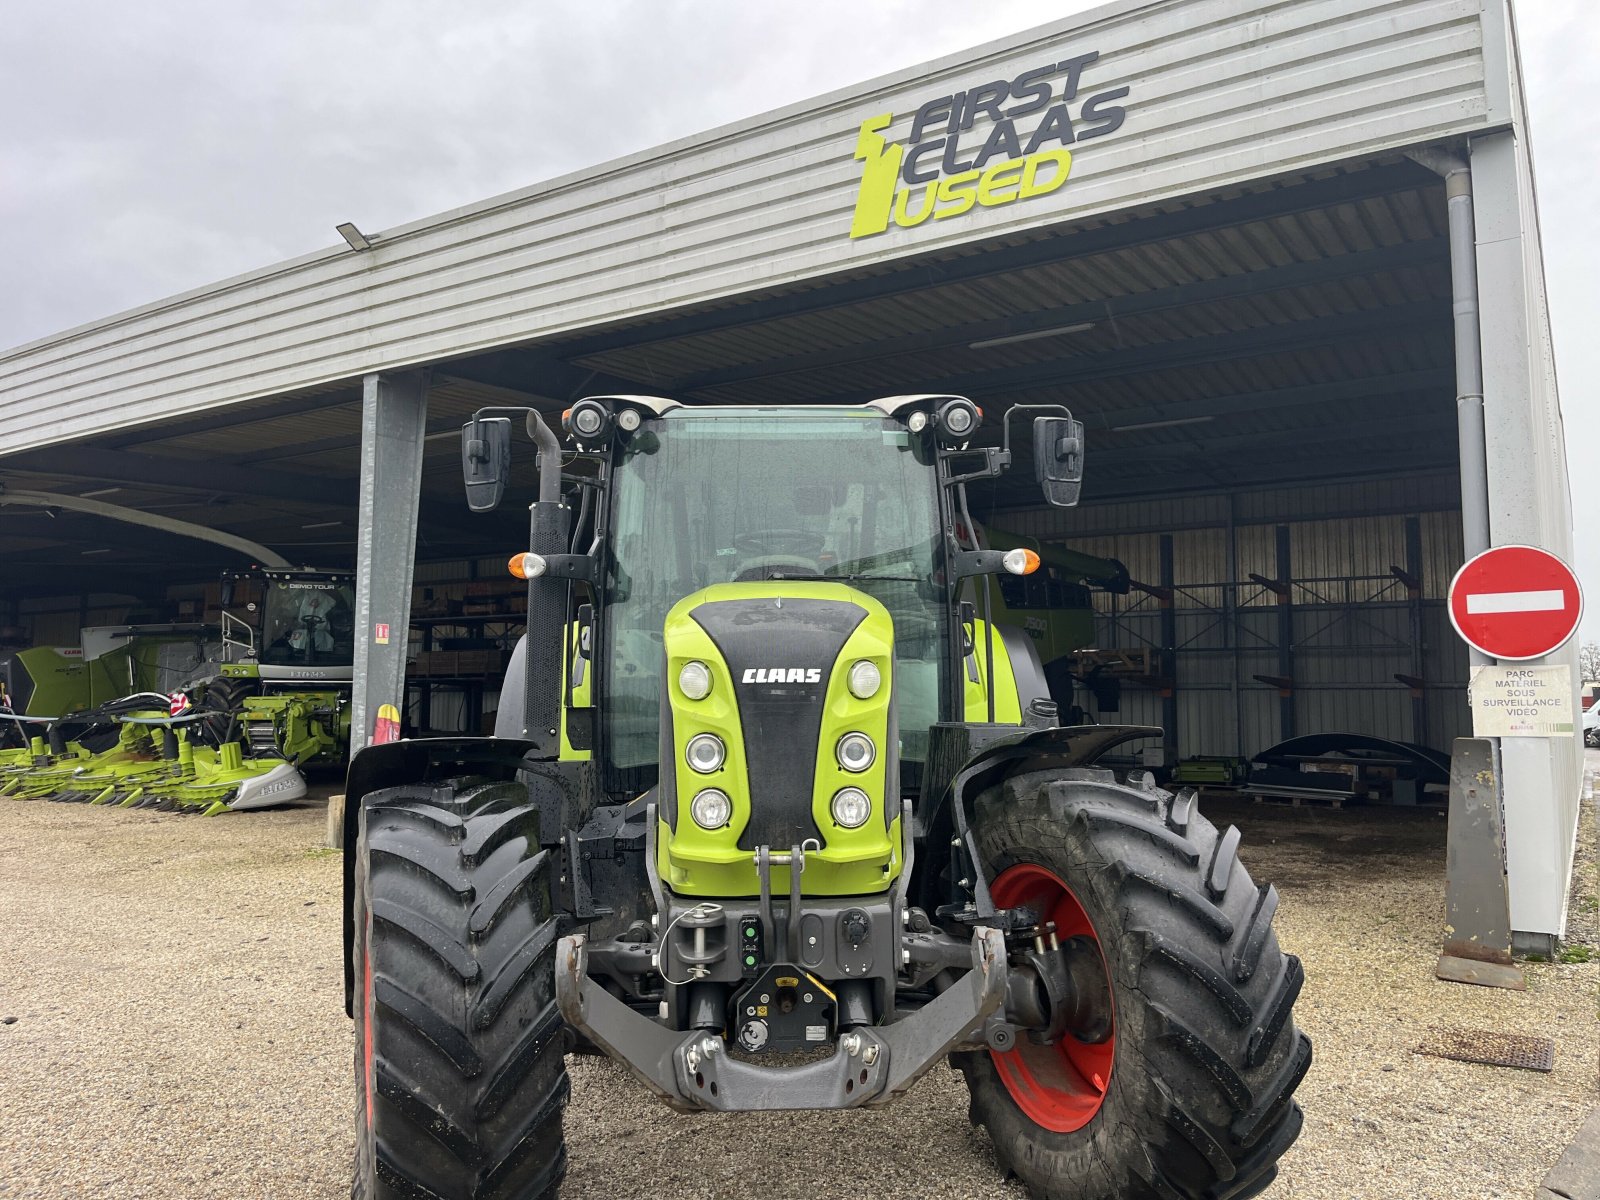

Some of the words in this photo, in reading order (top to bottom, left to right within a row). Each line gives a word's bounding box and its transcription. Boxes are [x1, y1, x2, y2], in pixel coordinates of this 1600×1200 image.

[909, 50, 1100, 144] FIRST
[903, 85, 1130, 185] CLAAS
[894, 148, 1073, 228] USED
[742, 668, 822, 683] CLAAS
[1506, 689, 1536, 697] SOUS
[1483, 699, 1561, 707] SURVEILLANCE
